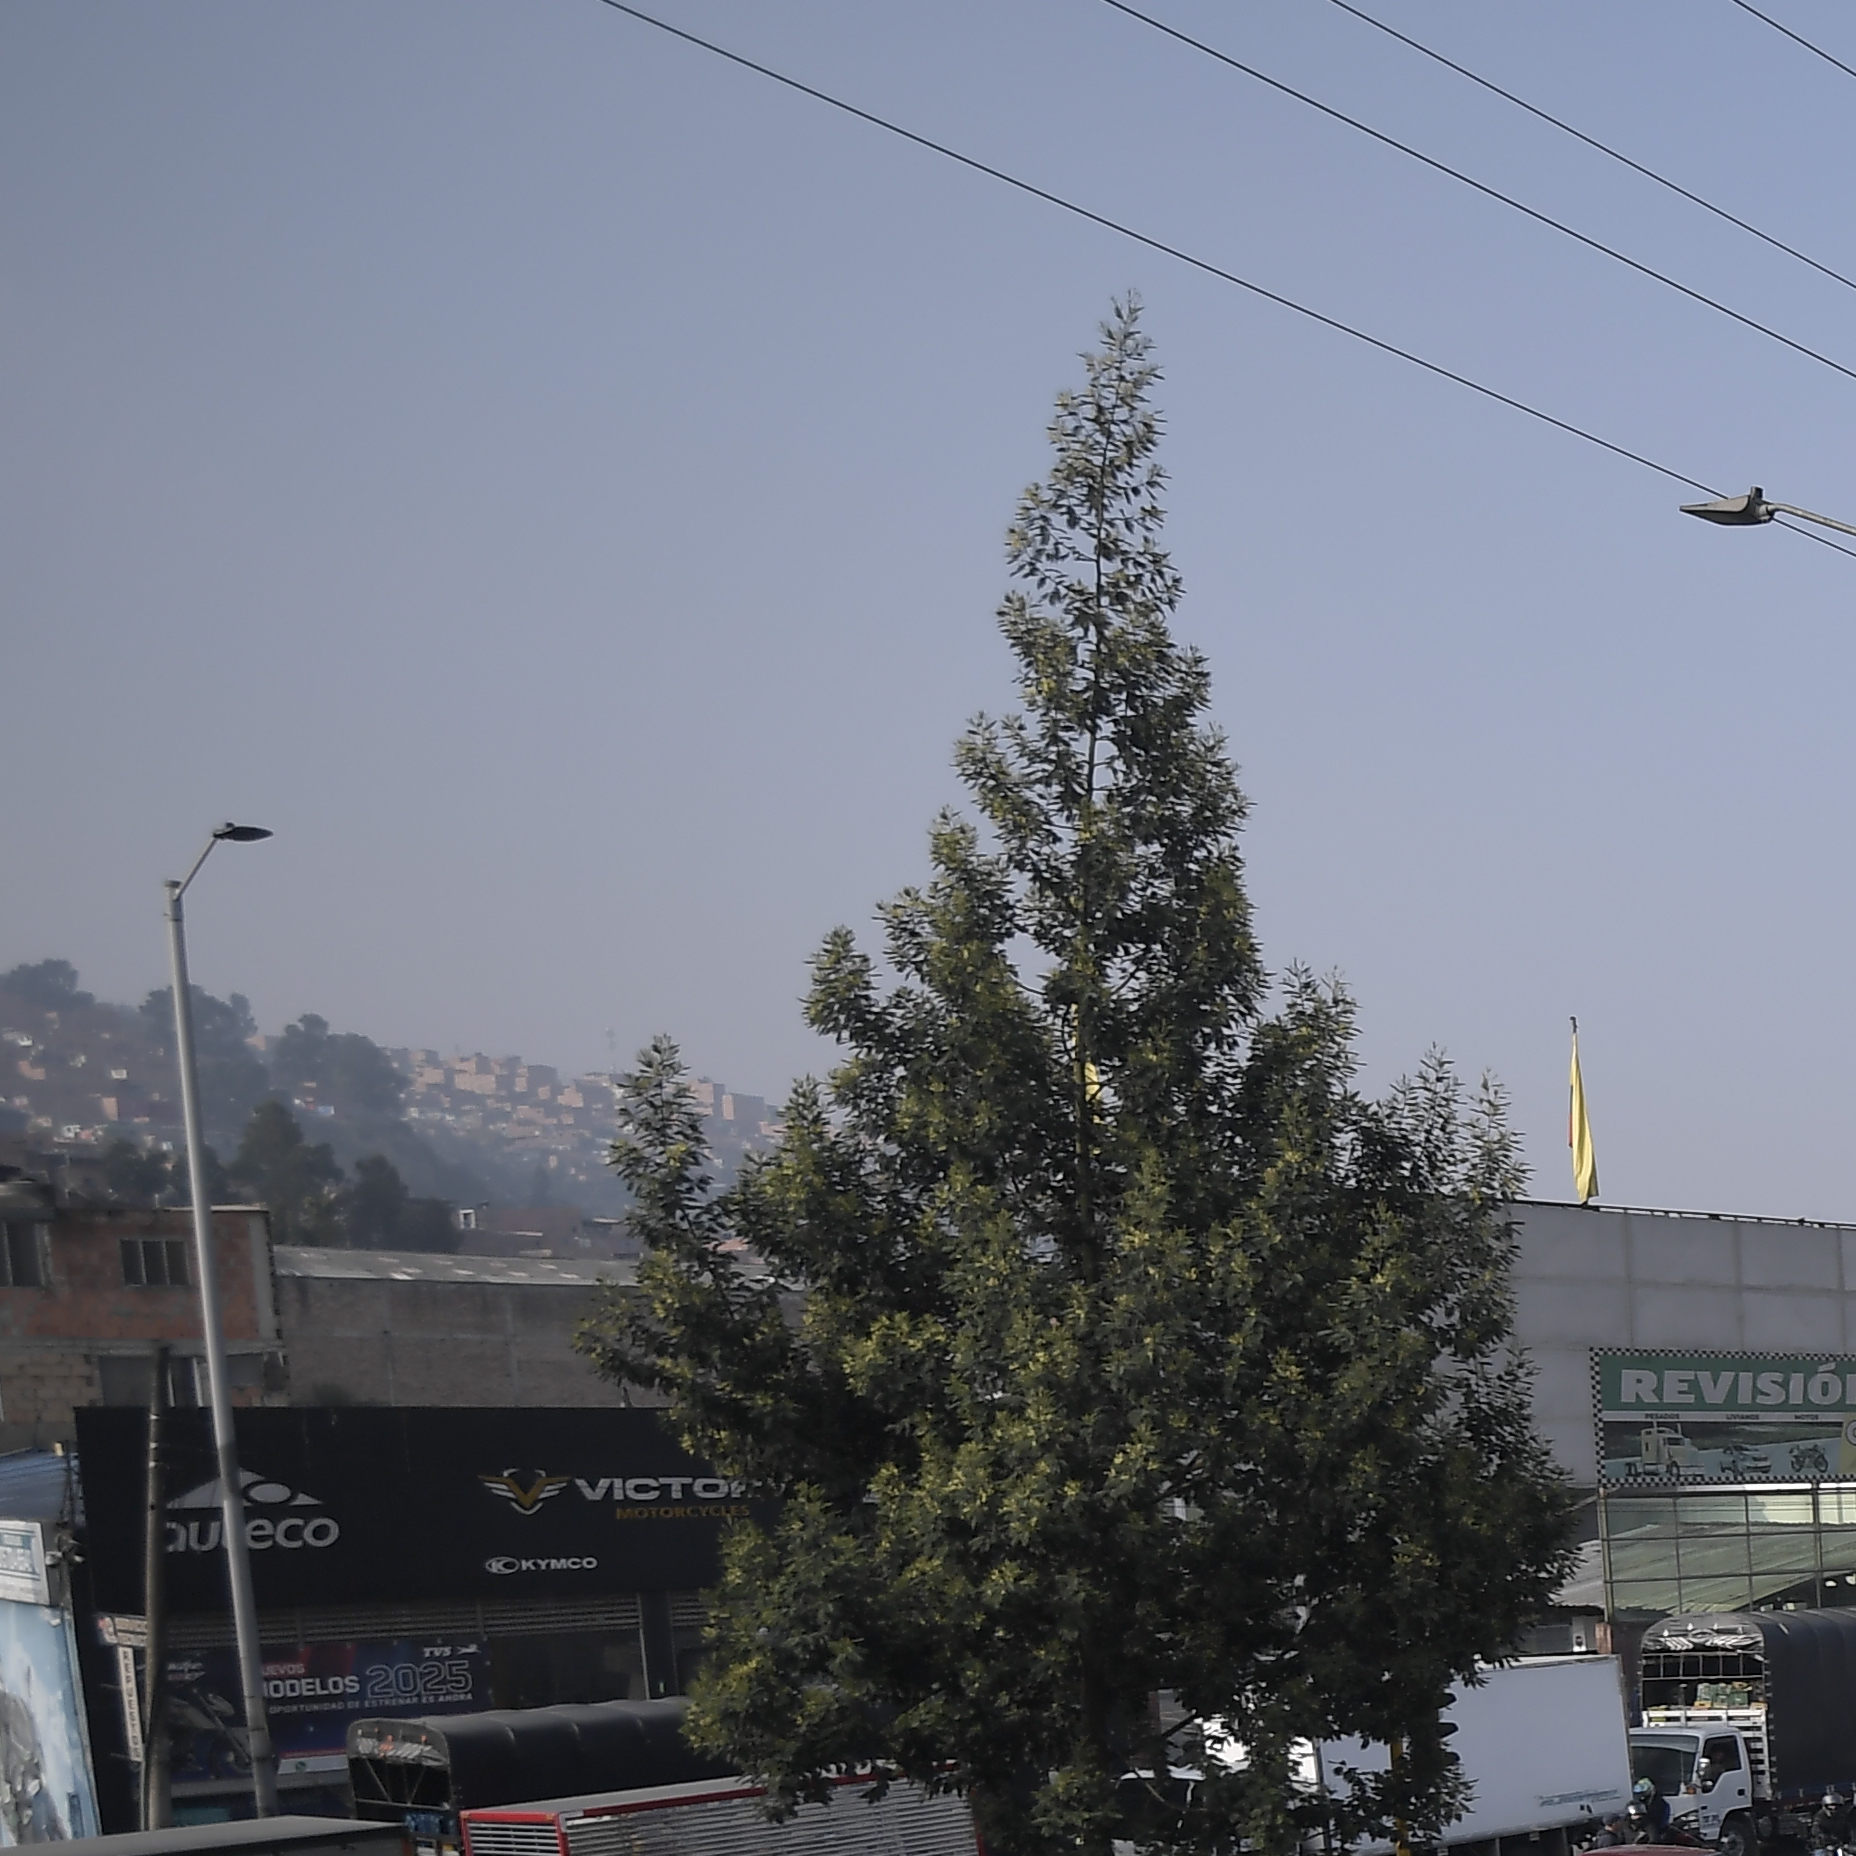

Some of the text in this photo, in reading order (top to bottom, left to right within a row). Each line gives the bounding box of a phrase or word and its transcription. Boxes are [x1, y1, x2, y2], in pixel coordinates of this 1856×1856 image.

[574, 1476, 786, 1501] VICTO
[616, 1504, 752, 1520] MOTORCYCLES
[165, 1516, 340, 1553] aueco
[521, 1556, 599, 1572] KYMCO
[423, 1645, 453, 1658] TVS
[262, 1662, 306, 1677] UEVOS
[367, 1660, 474, 1699] 2025
[263, 1675, 361, 1699] ODELOS
